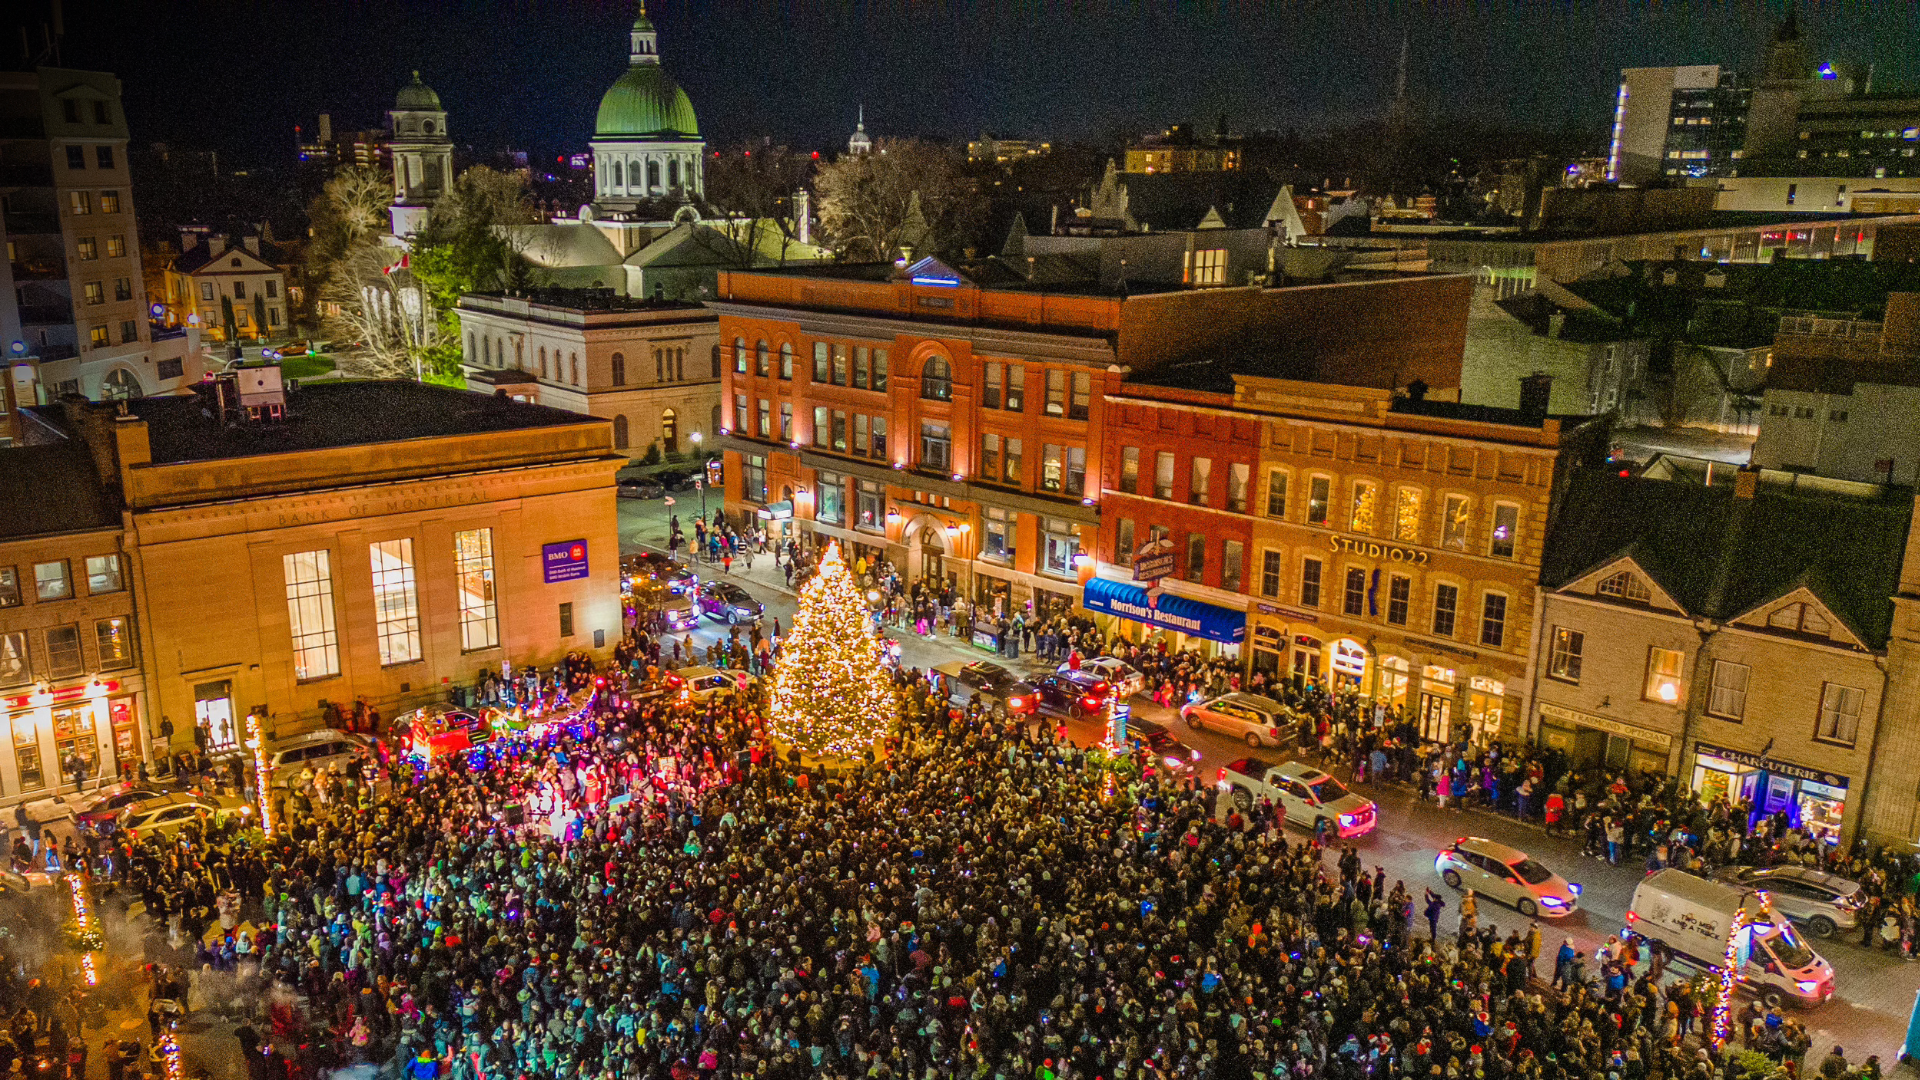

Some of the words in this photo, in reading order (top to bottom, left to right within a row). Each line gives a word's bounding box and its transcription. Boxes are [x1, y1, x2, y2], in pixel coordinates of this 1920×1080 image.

[279, 510, 330, 525] BANK
[349, 503, 368, 516] OF
[387, 490, 490, 512] MONTREAL
[548, 551, 569, 561] BMO
[1110, 598, 1152, 619] Morrison's
[1154, 610, 1201, 631] Restaurant
[1579, 715, 1620, 731] RAYMOND
[1722, 751, 1819, 781] CHARCUTERIE
[1681, 913, 1698, 924] TWO
[1699, 920, 1716, 931] MEN
